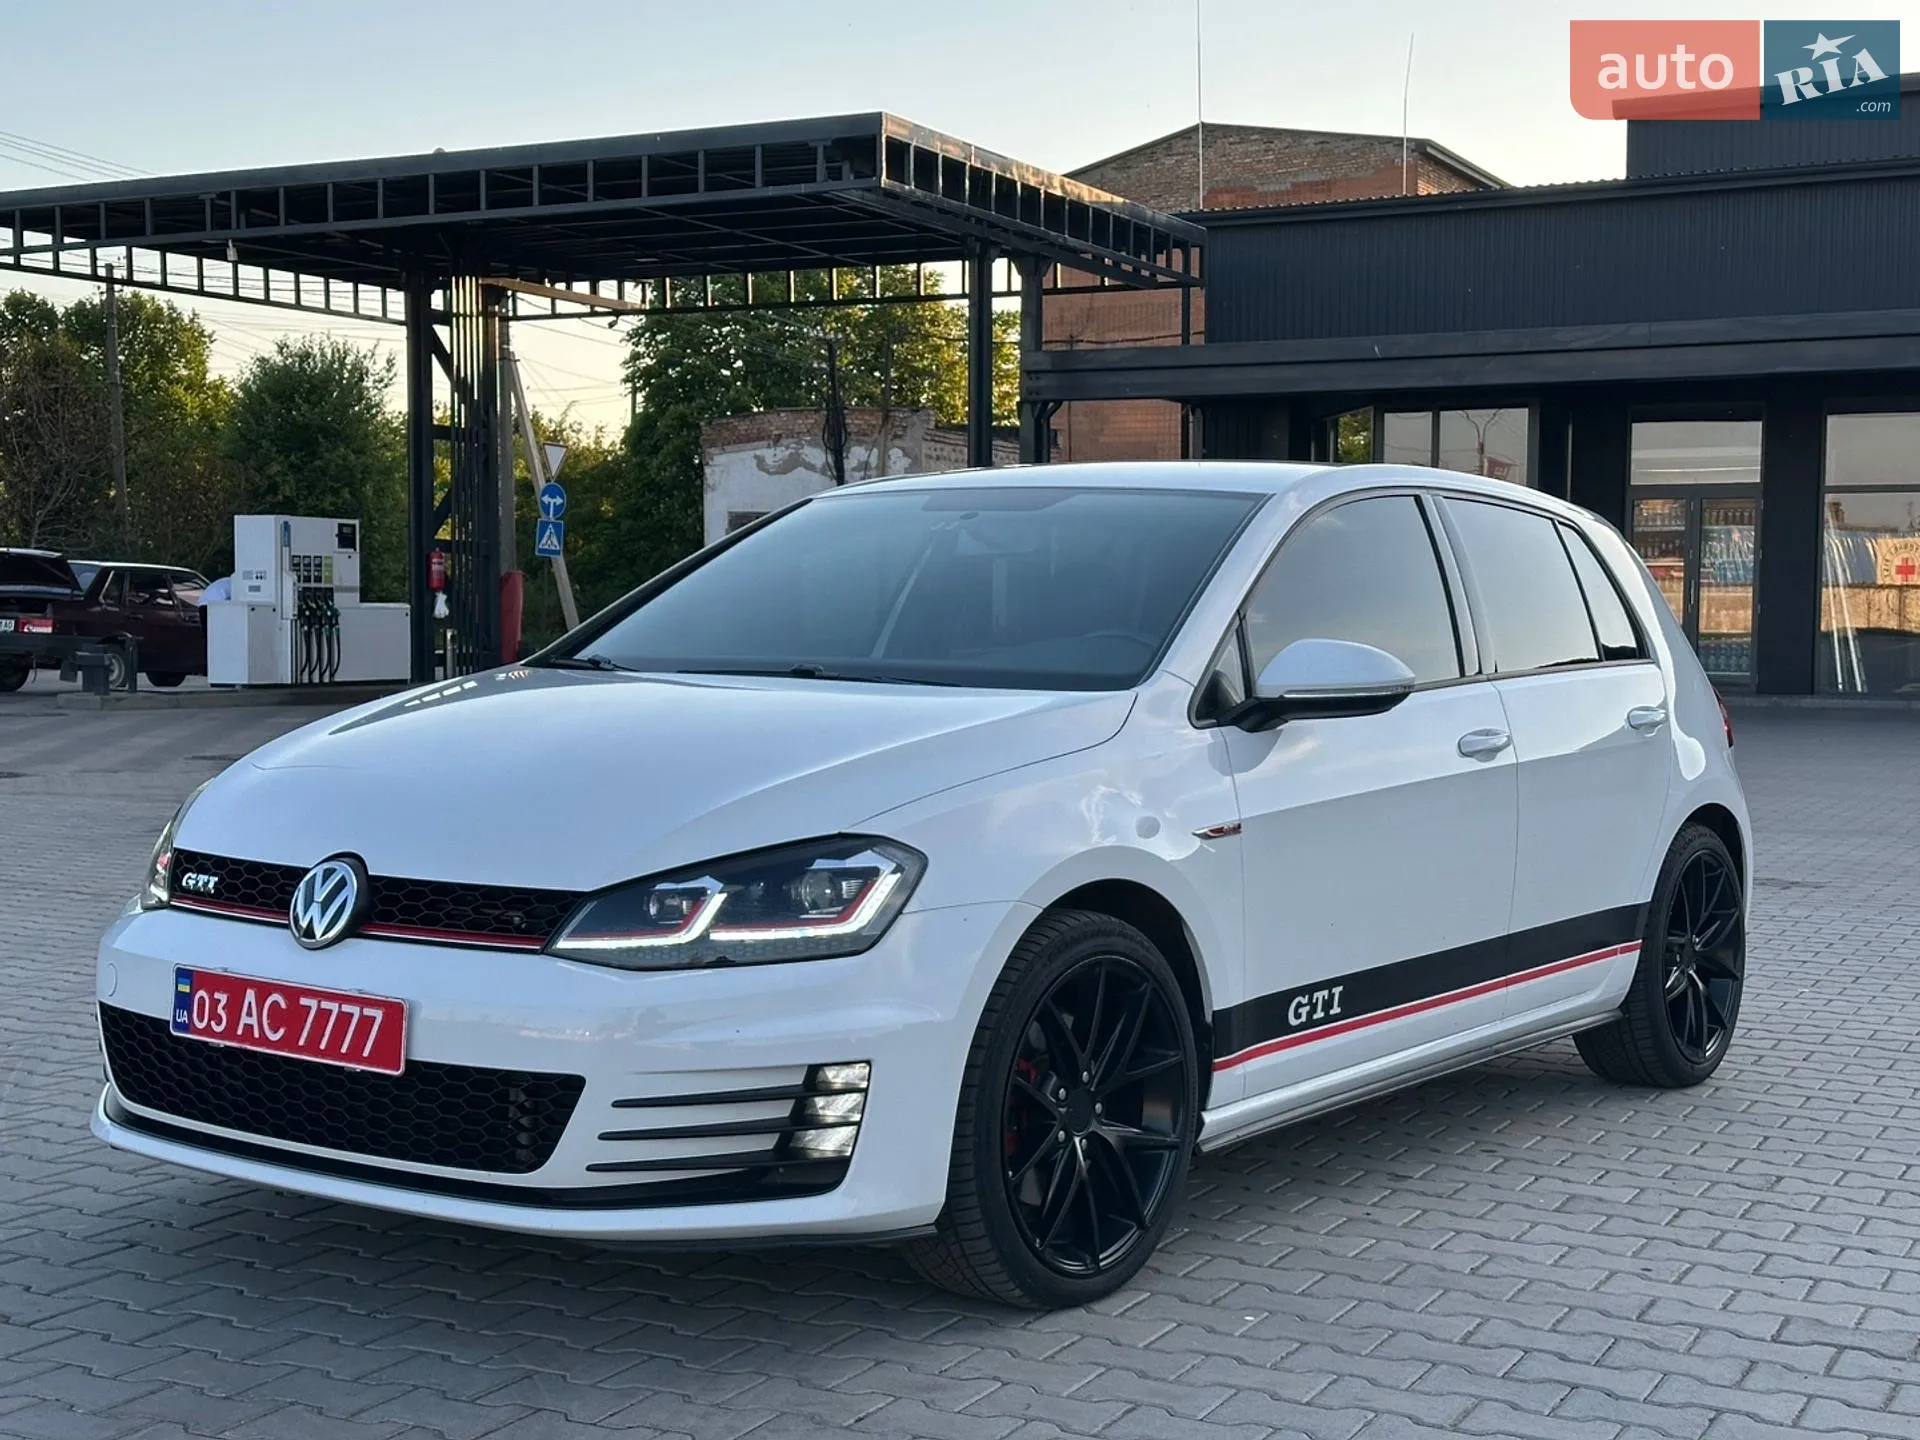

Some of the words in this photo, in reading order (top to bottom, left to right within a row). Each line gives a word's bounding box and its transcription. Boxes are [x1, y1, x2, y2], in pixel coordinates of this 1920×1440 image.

[182, 871, 219, 894] GTI
[175, 1008, 188, 1024] UA
[1287, 985, 1344, 1027] GTI
[192, 989, 228, 1033] 03
[236, 988, 288, 1042] AC
[298, 997, 384, 1058] 7777
